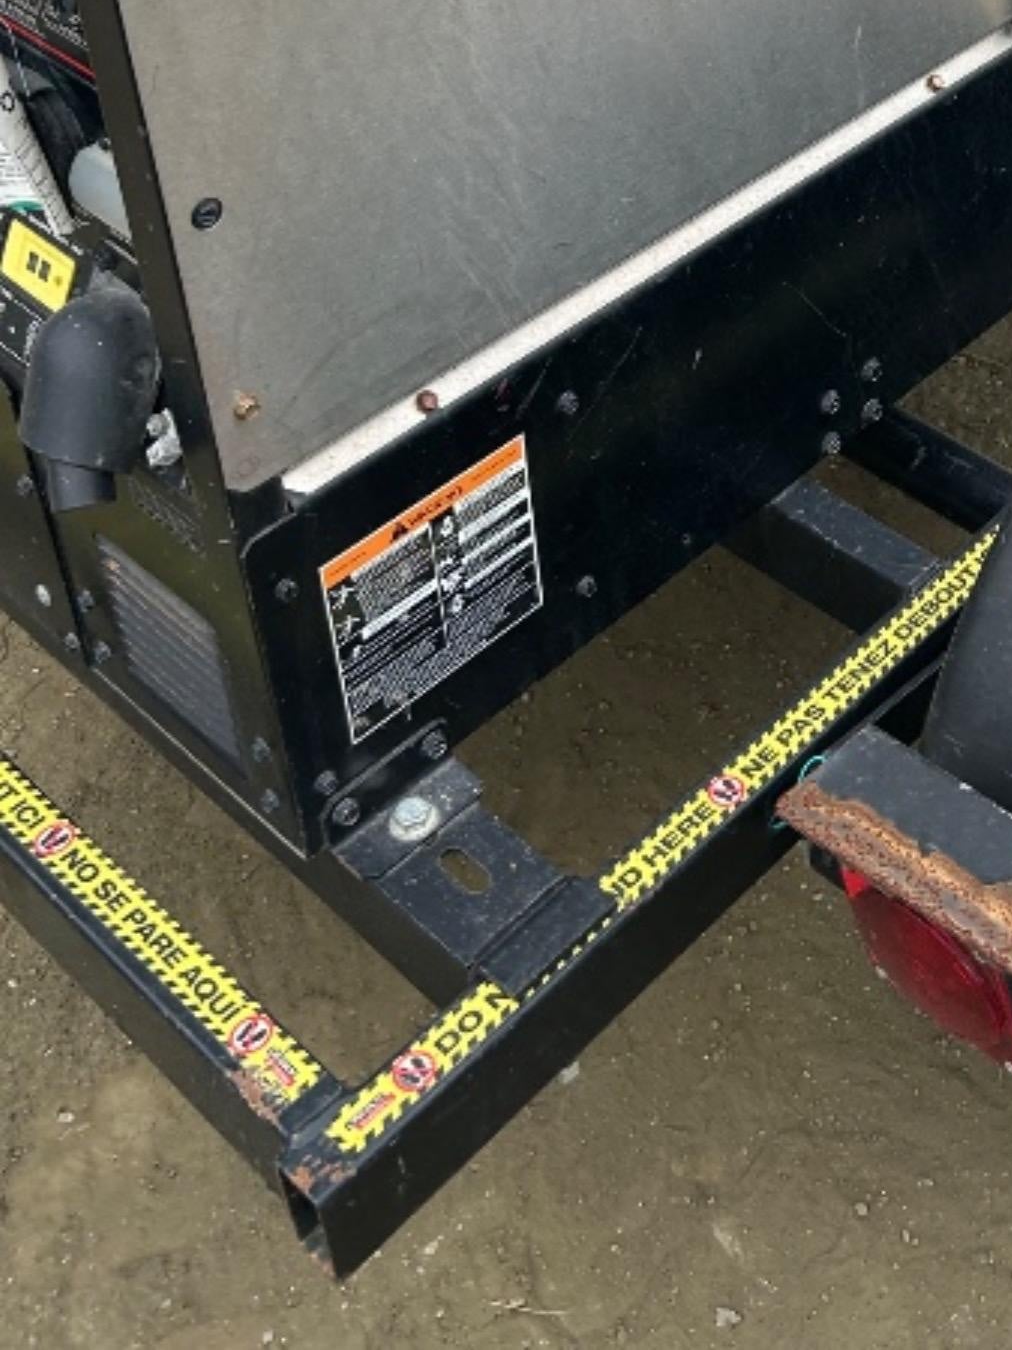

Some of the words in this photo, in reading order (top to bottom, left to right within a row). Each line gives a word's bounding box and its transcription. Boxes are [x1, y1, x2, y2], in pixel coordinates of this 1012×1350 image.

[741, 746, 779, 780] NE
[776, 704, 827, 747] PAS
[823, 641, 898, 700] TENEZ
[893, 564, 975, 640] DEBOUT
[12, 798, 46, 830] ICI
[643, 802, 715, 864] HERE
[59, 847, 100, 884] NO
[93, 881, 131, 913] SE
[124, 909, 188, 968] PARE
